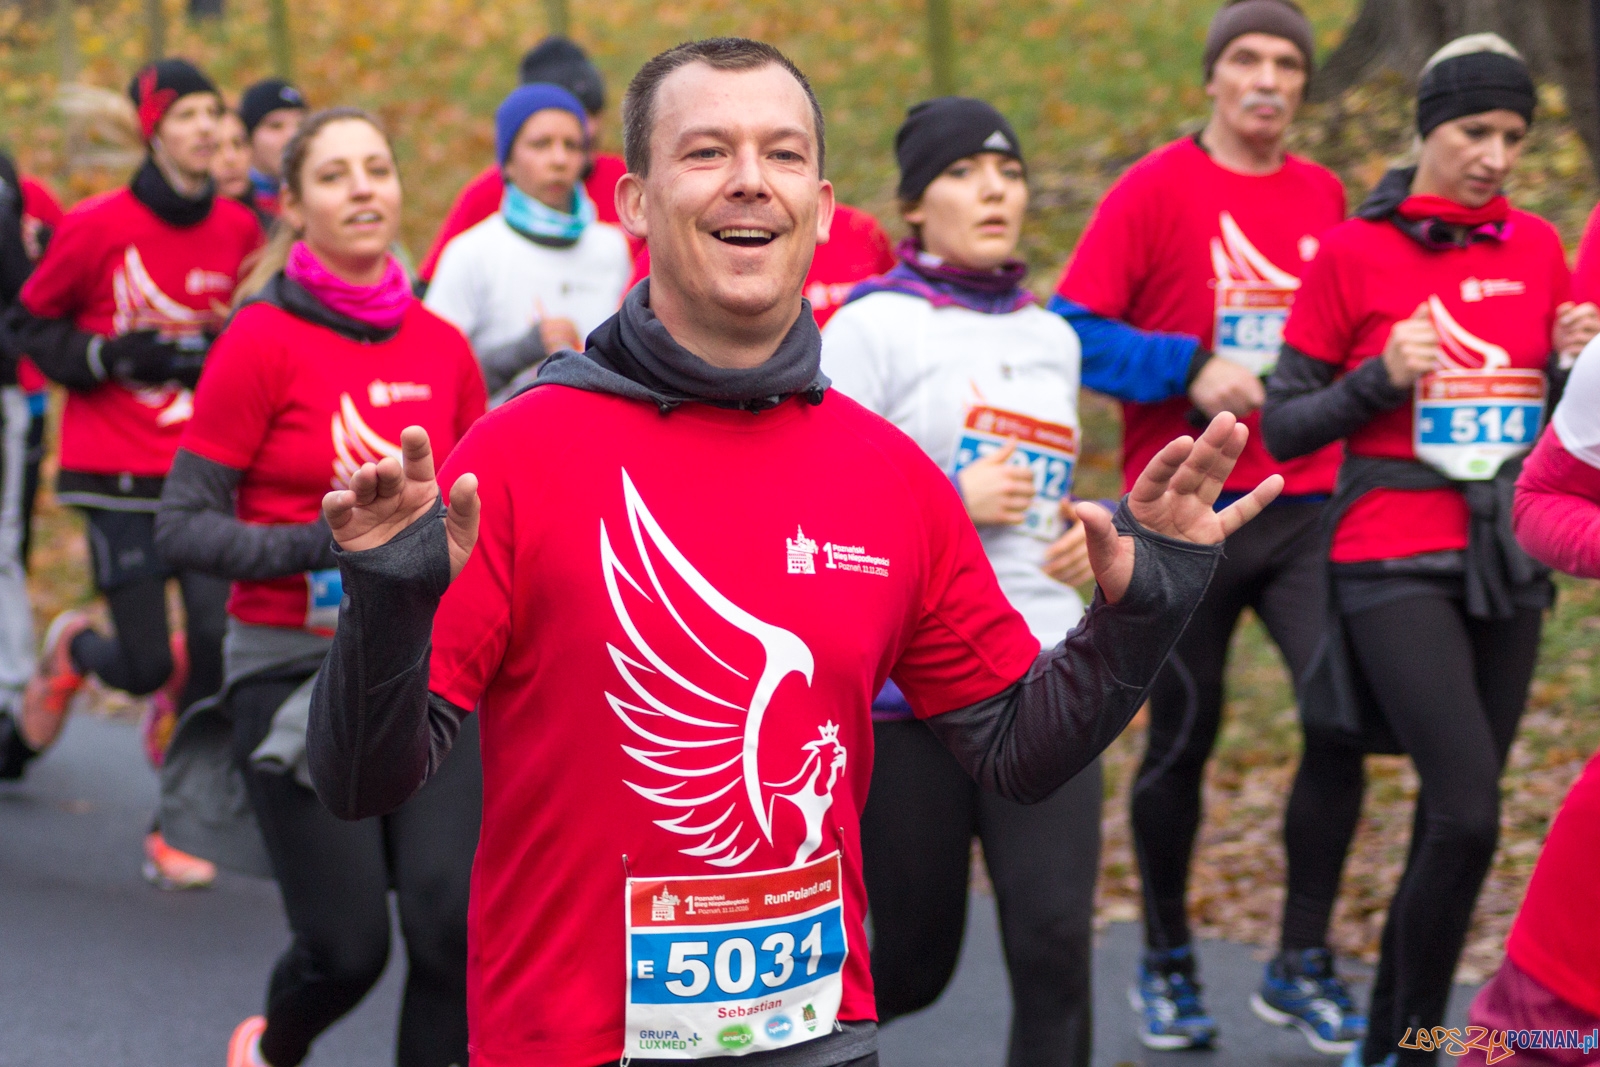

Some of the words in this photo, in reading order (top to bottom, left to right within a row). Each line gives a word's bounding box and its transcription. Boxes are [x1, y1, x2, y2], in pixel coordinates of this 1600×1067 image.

[1450, 406, 1526, 442] 514
[764, 879, 832, 906] RunPoland.org
[637, 960, 655, 980] E
[665, 922, 822, 997] 5031
[717, 998, 783, 1020] Sebastian
[639, 1030, 680, 1040] GRUPA
[639, 1039, 687, 1050] LUXMED
